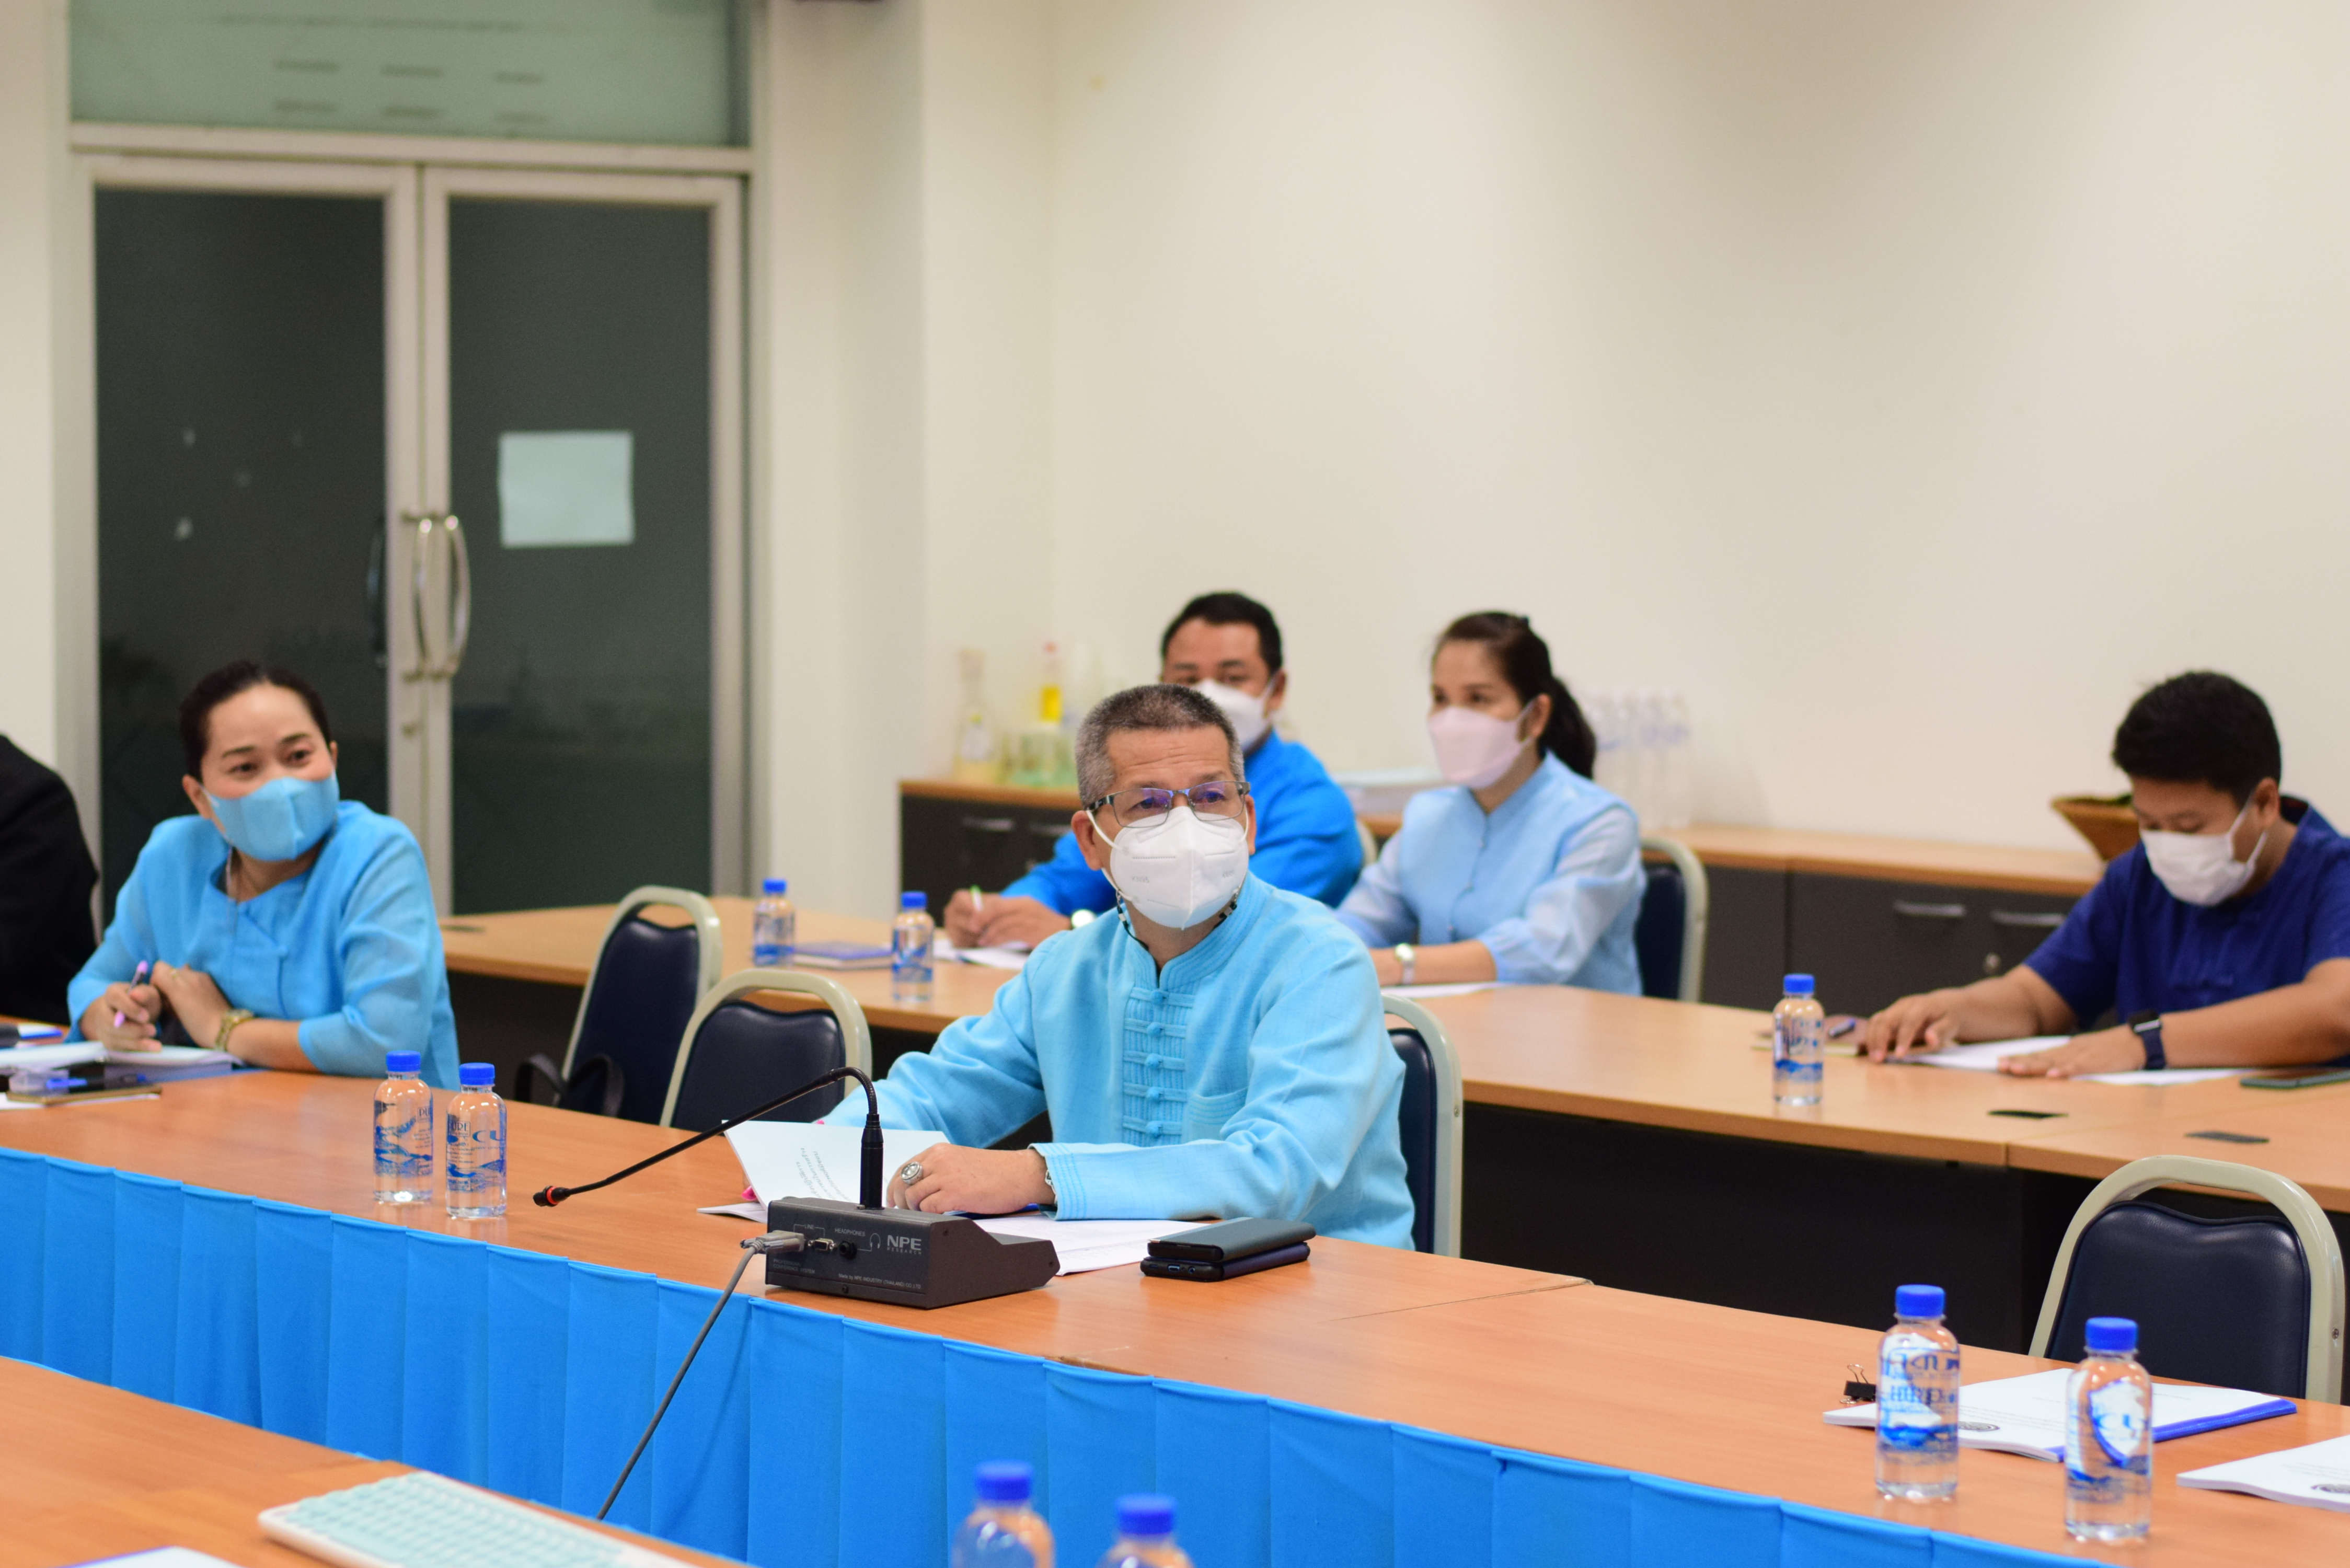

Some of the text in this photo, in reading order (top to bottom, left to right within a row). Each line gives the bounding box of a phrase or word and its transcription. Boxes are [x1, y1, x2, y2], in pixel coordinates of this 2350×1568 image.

[1131, 875, 1149, 884] KN95
[835, 1228, 866, 1237] HEADPHONES
[887, 1235, 922, 1251] NPE
[886, 1247, 922, 1255] RESEARCH
